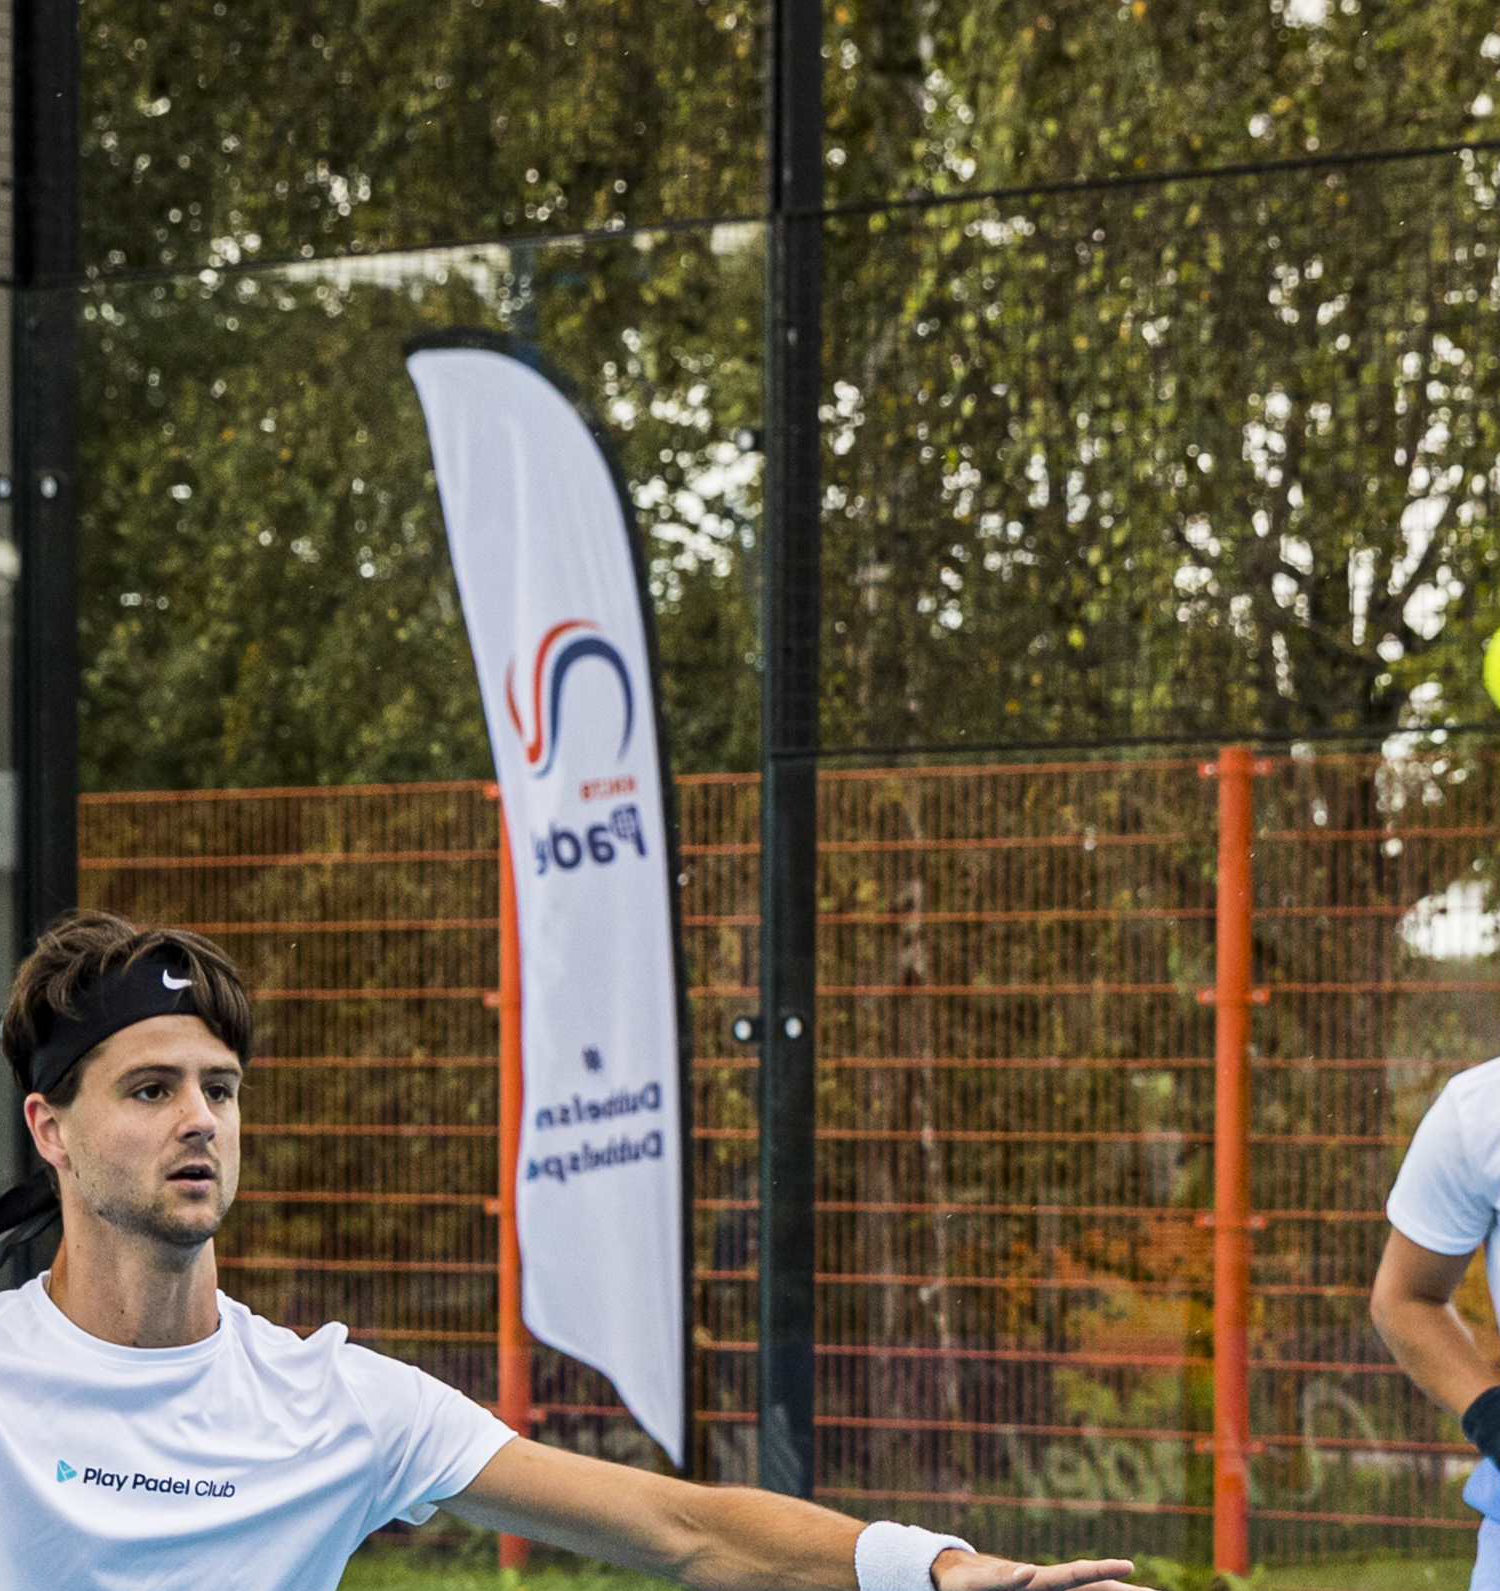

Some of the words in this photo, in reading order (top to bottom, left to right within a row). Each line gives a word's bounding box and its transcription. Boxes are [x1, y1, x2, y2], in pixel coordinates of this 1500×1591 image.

[83, 1467, 128, 1492] Play
[132, 1473, 190, 1495] Padel
[194, 1479, 236, 1498] Club
